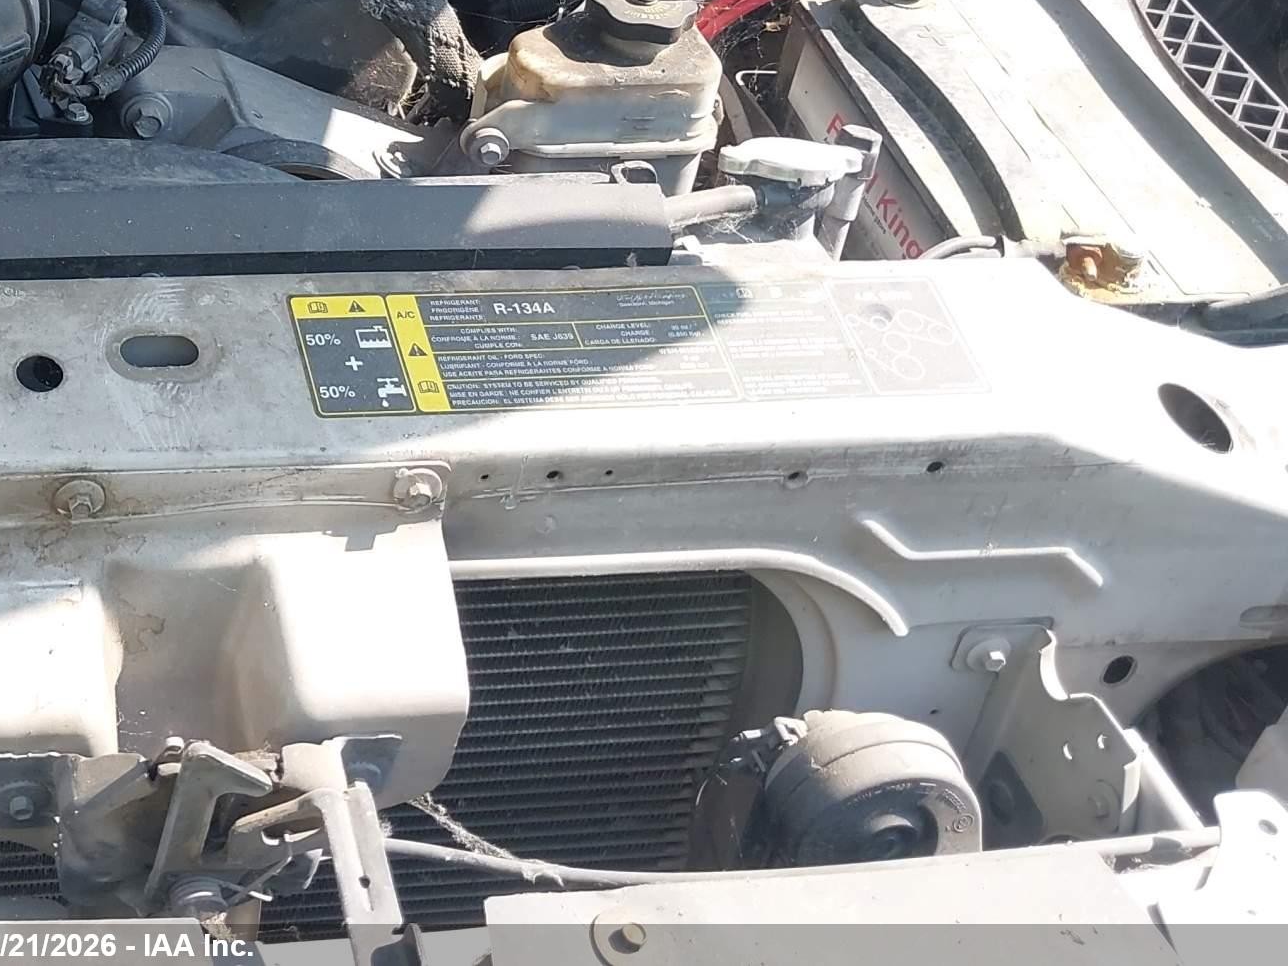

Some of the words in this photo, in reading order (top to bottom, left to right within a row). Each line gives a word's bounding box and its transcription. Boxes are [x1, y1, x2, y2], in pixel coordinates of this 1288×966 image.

[492, 302, 556, 314] R-134A
[397, 311, 415, 319] A/C
[305, 333, 341, 346] 50%
[552, 332, 574, 340] J639
[319, 385, 356, 398] 50%
